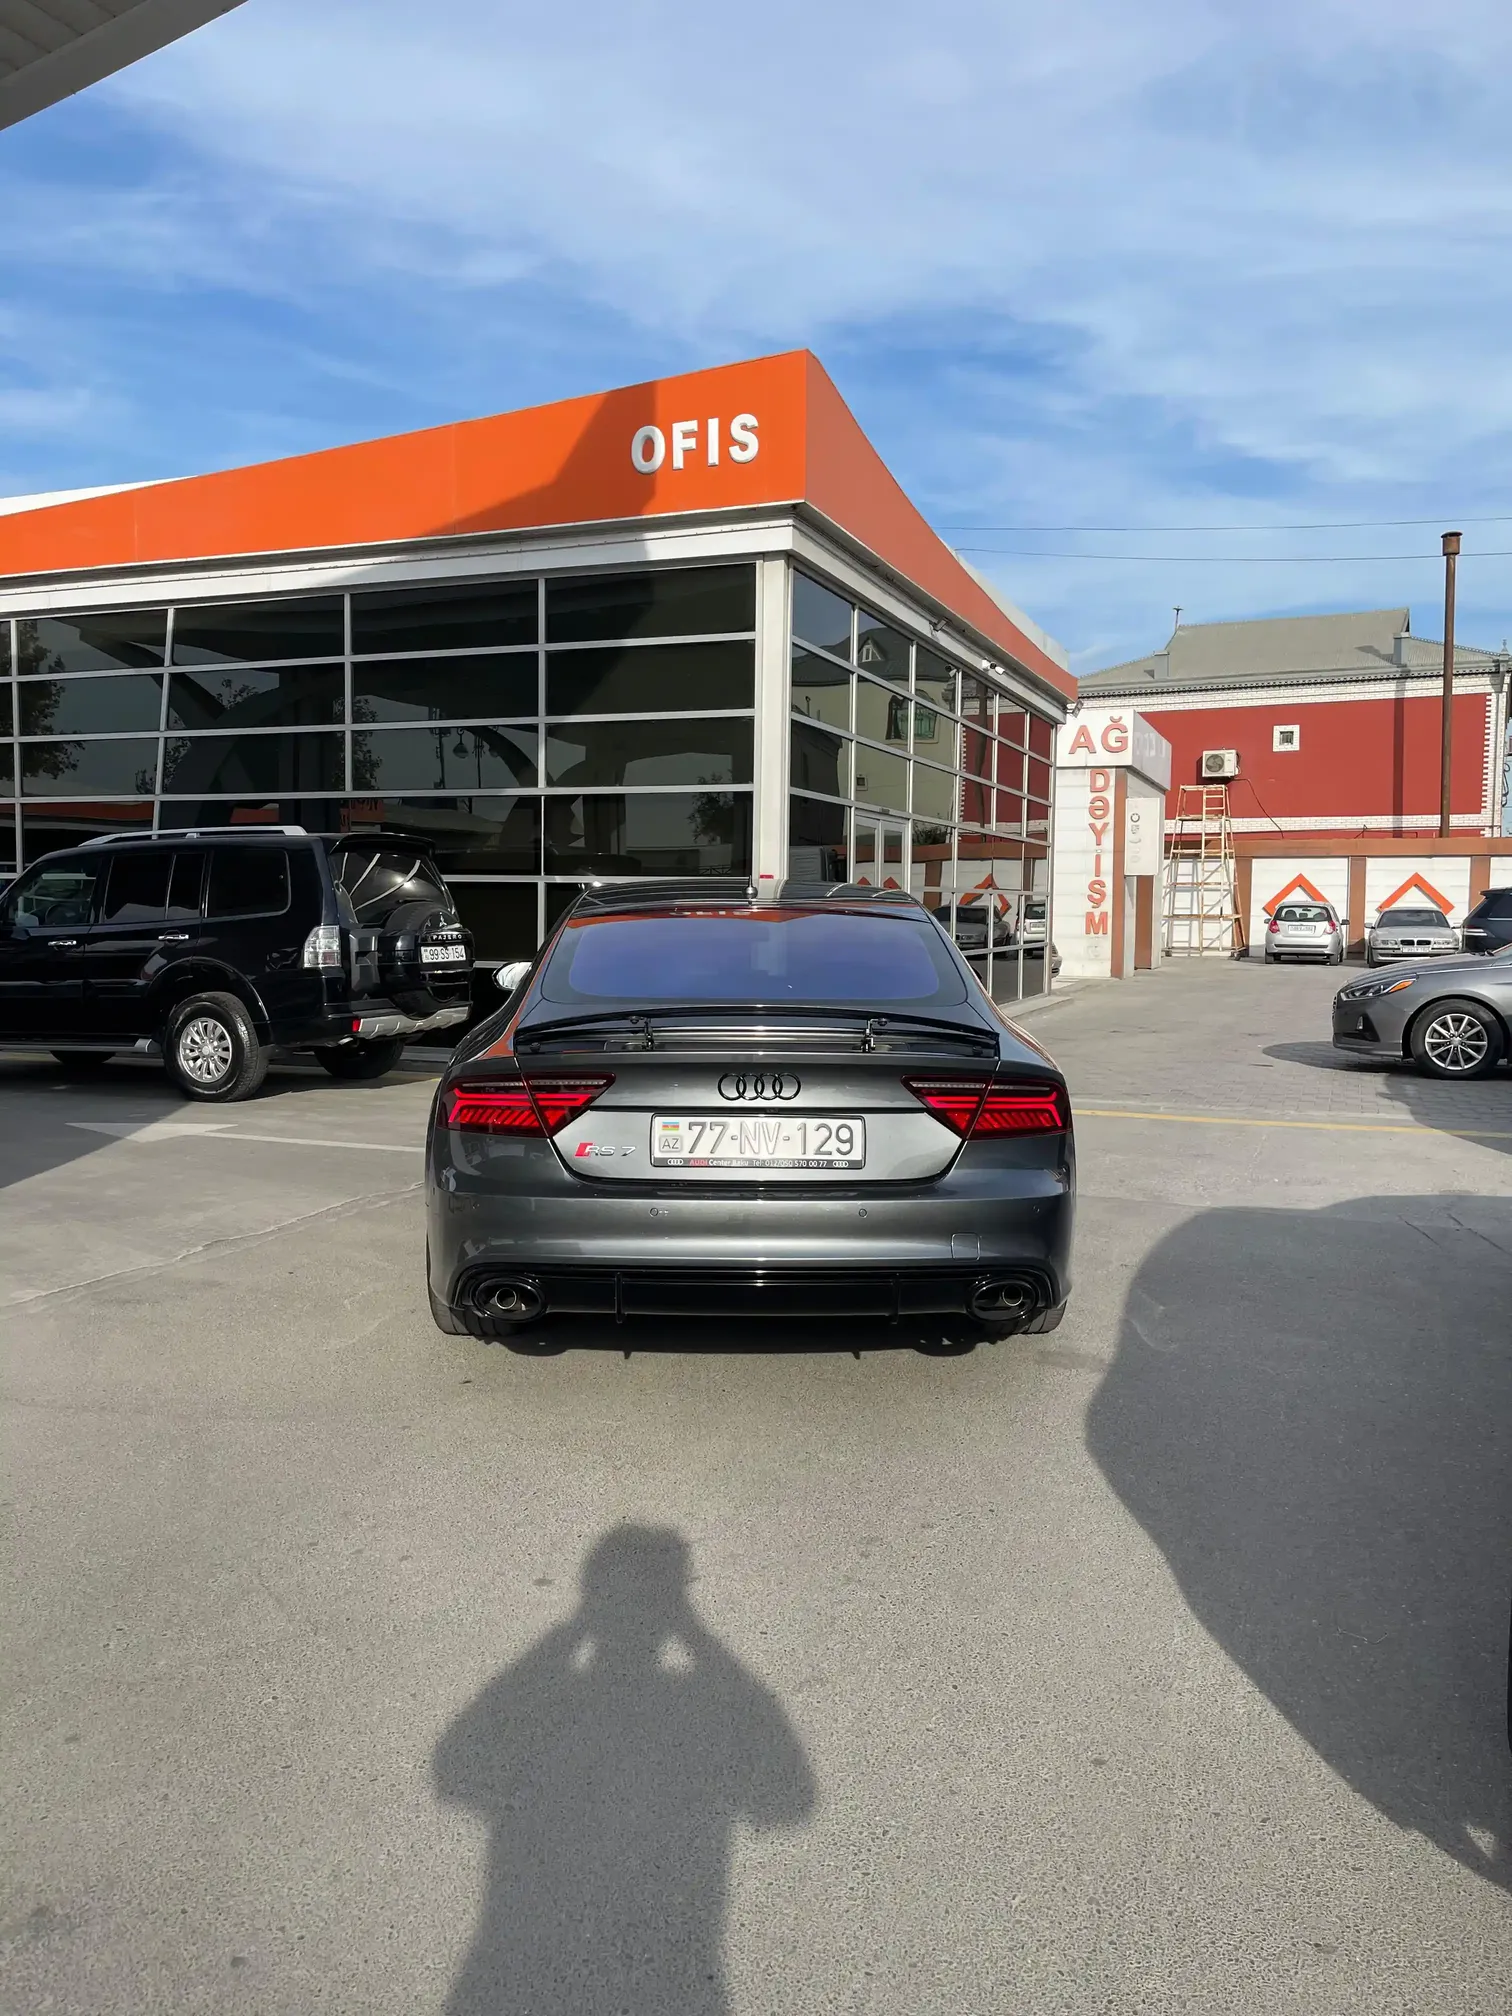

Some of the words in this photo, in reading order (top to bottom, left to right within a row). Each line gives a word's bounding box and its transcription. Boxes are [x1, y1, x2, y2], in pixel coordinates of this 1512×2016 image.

[631, 413, 759, 475] OFIS
[662, 1138, 680, 1150] AZ
[688, 1121, 854, 1156] 77-NV-129
